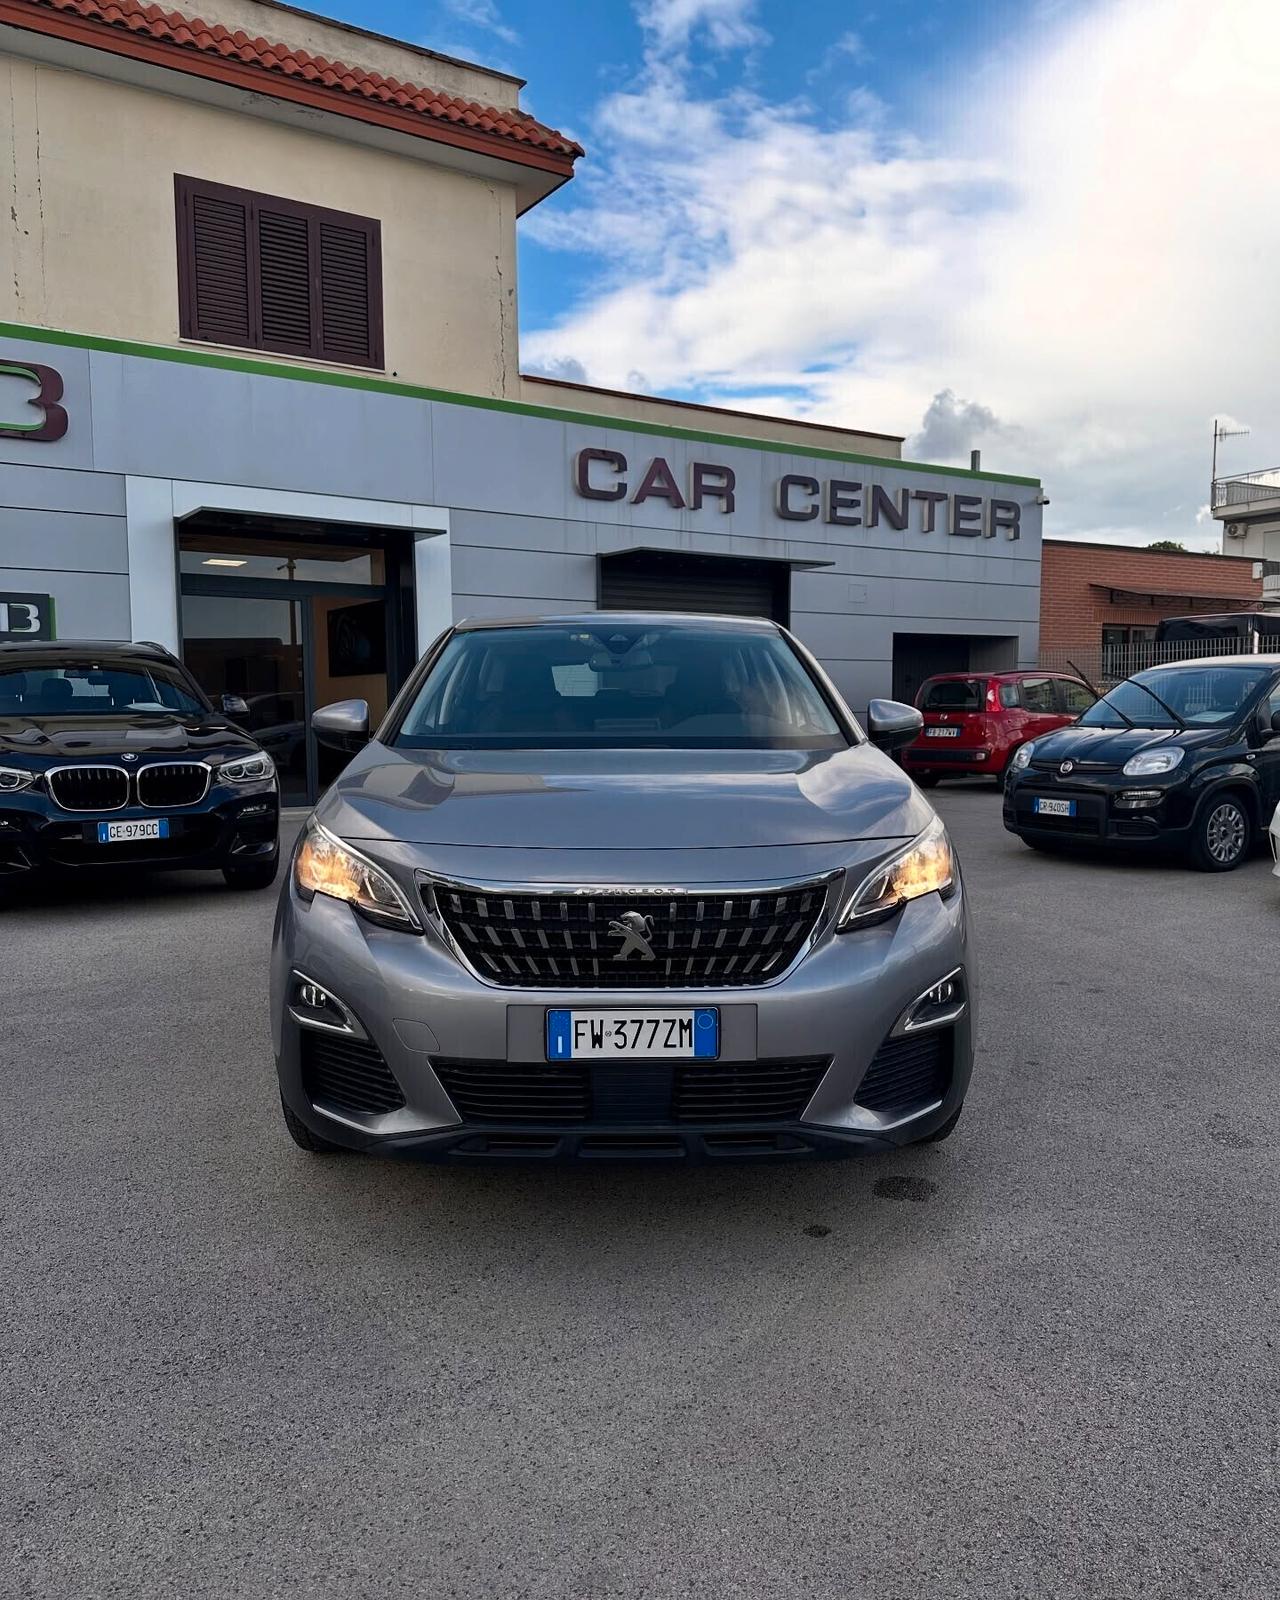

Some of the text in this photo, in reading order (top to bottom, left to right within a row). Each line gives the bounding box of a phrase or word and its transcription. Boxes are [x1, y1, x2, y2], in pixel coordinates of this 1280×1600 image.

[575, 447, 1021, 541] CAR CENTER
[588, 888, 676, 896] PEUGEOT
